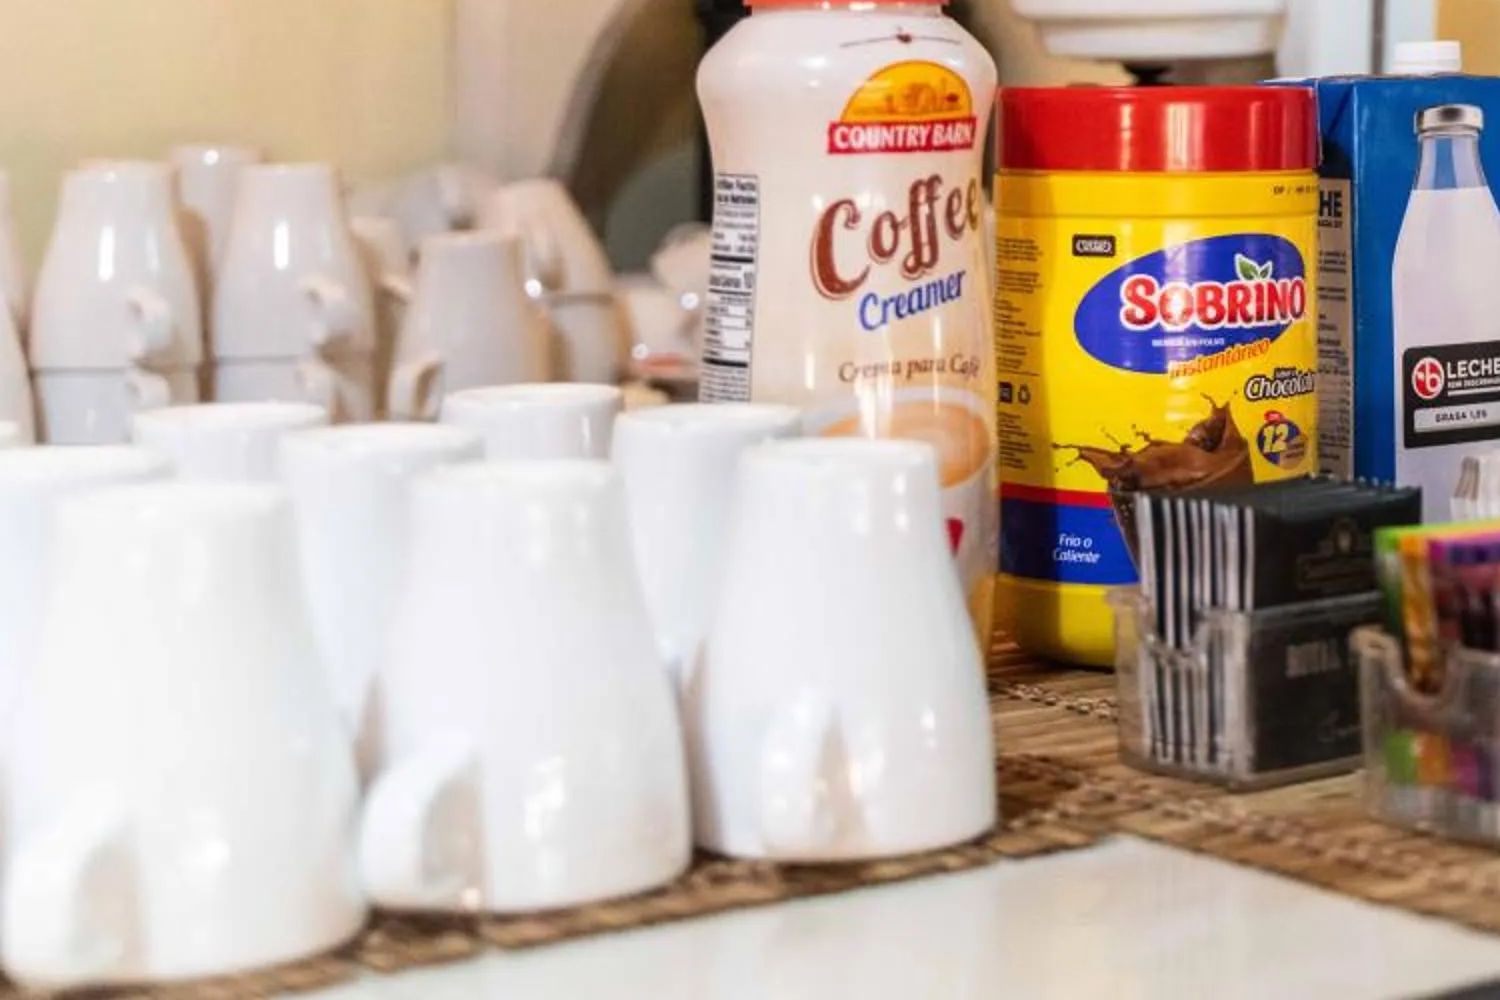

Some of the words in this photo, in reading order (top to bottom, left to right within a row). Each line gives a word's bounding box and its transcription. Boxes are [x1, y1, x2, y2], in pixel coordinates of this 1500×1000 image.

[834, 124, 931, 149] COUNTRY
[931, 122, 973, 146] BARN
[810, 174, 979, 300] Coffee
[859, 269, 967, 331] Creamer
[1121, 275, 1307, 329] SOBRINO
[906, 358, 946, 380] para
[1263, 424, 1289, 453] 12
[1053, 548, 1101, 564] Caliente
[1083, 537, 1093, 549] o
